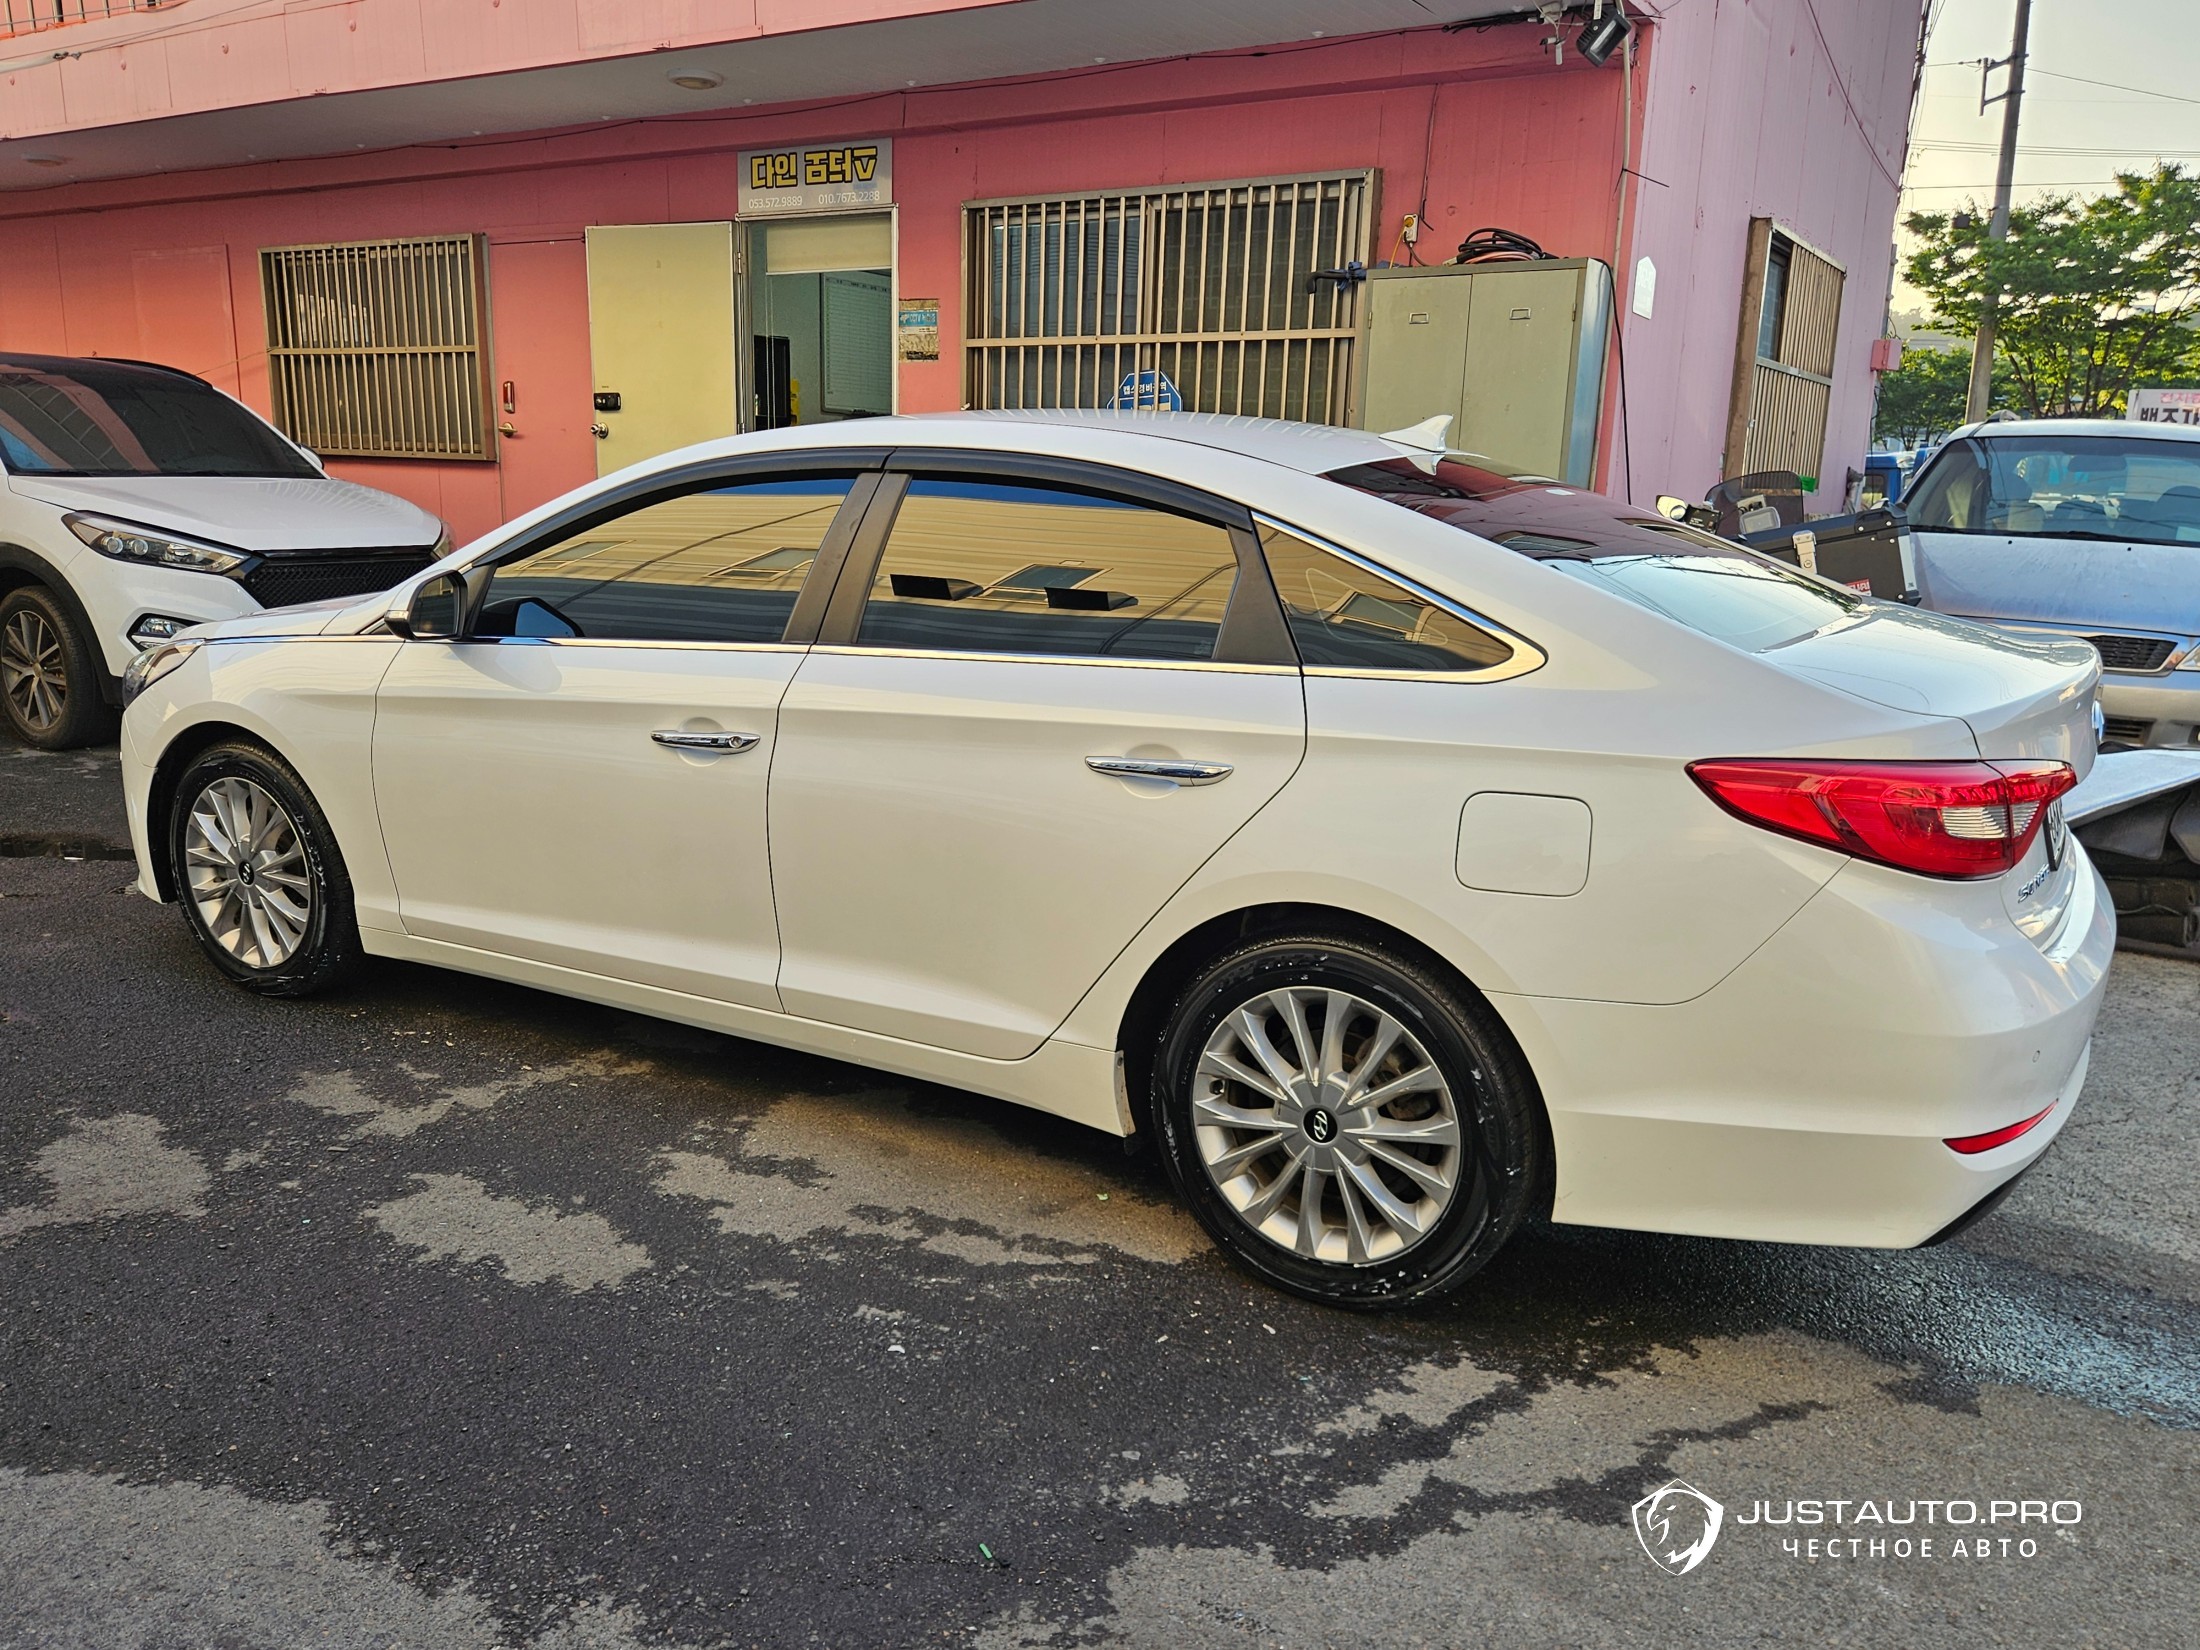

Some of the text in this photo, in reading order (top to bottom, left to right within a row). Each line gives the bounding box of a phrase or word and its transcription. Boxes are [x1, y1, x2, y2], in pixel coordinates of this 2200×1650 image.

[750, 152, 798, 189] 다인
[749, 191, 880, 209] 053.572.9889 010.7673.2288
[1123, 381, 1167, 395] 캡경비역
